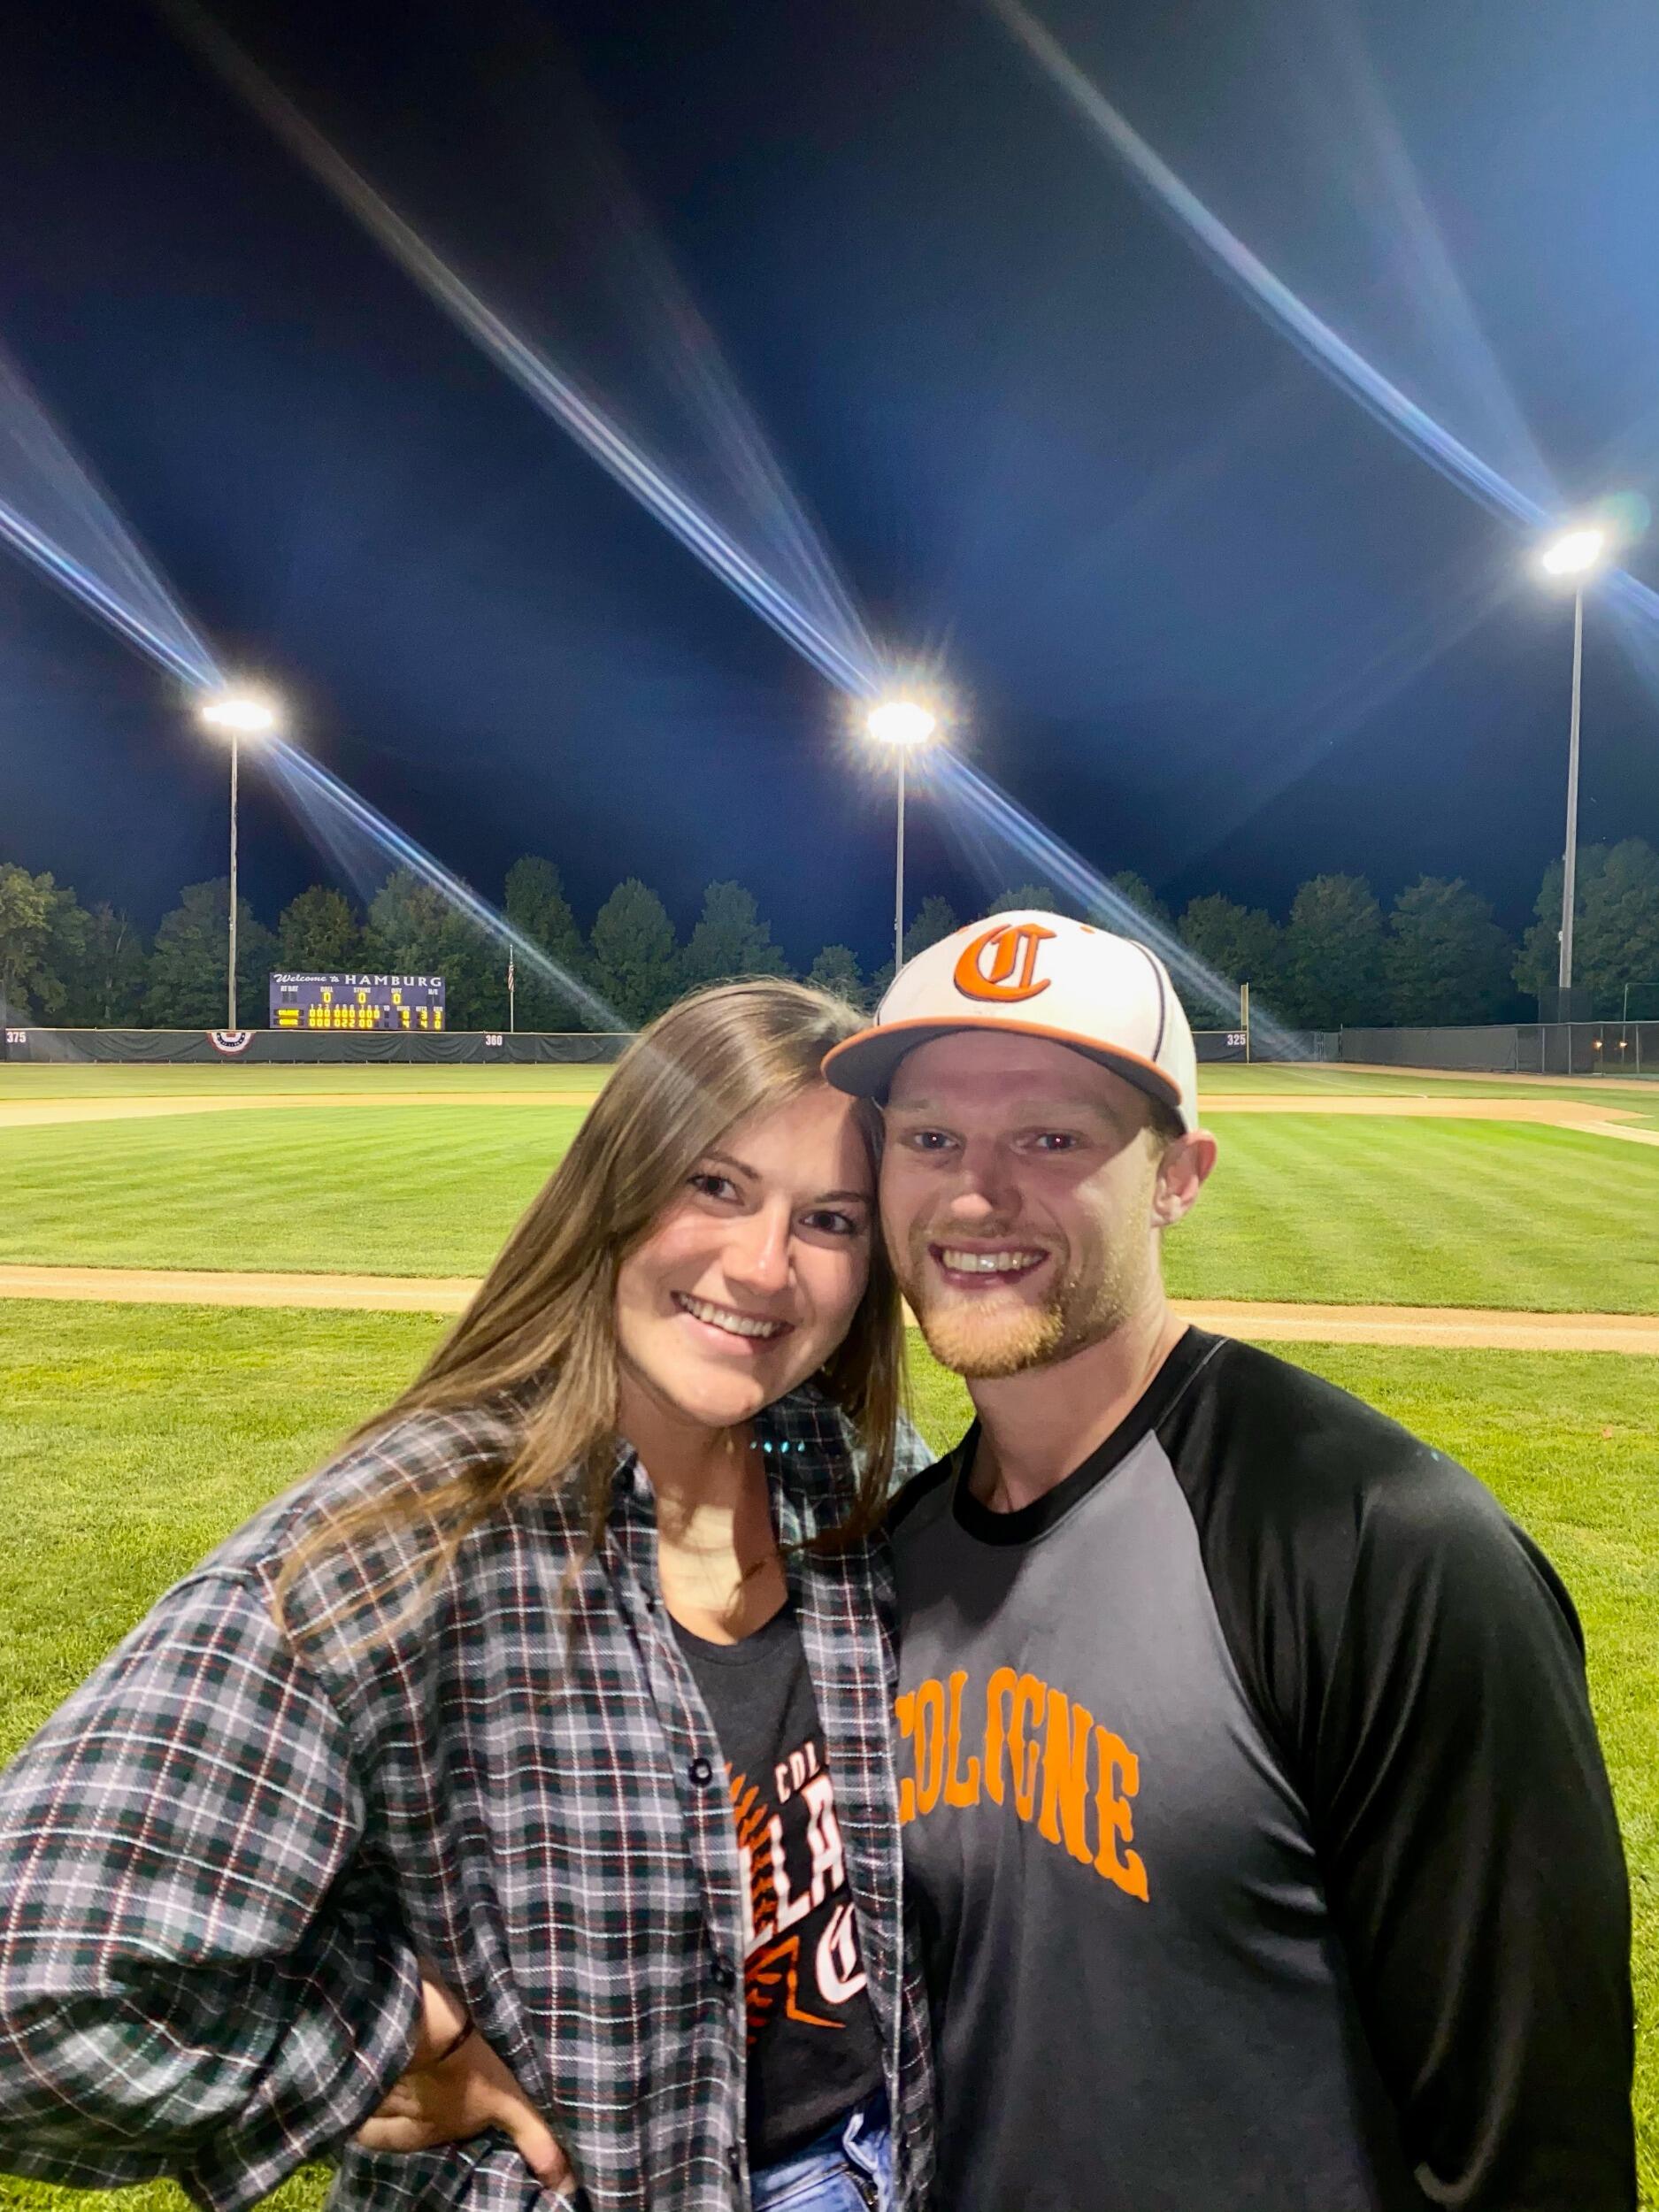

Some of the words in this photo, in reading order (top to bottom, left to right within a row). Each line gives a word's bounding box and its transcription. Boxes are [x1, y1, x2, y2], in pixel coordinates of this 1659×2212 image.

[953, 923, 1057, 1002] C
[273, 974, 327, 983] Welcome
[345, 975, 442, 987] HAMBURG
[323, 992, 331, 1003] 0
[358, 993, 366, 1004] 0
[393, 994, 401, 1004] 0
[6, 1032, 27, 1043] 375
[486, 1034, 503, 1046] 360
[1227, 1033, 1246, 1046] 325
